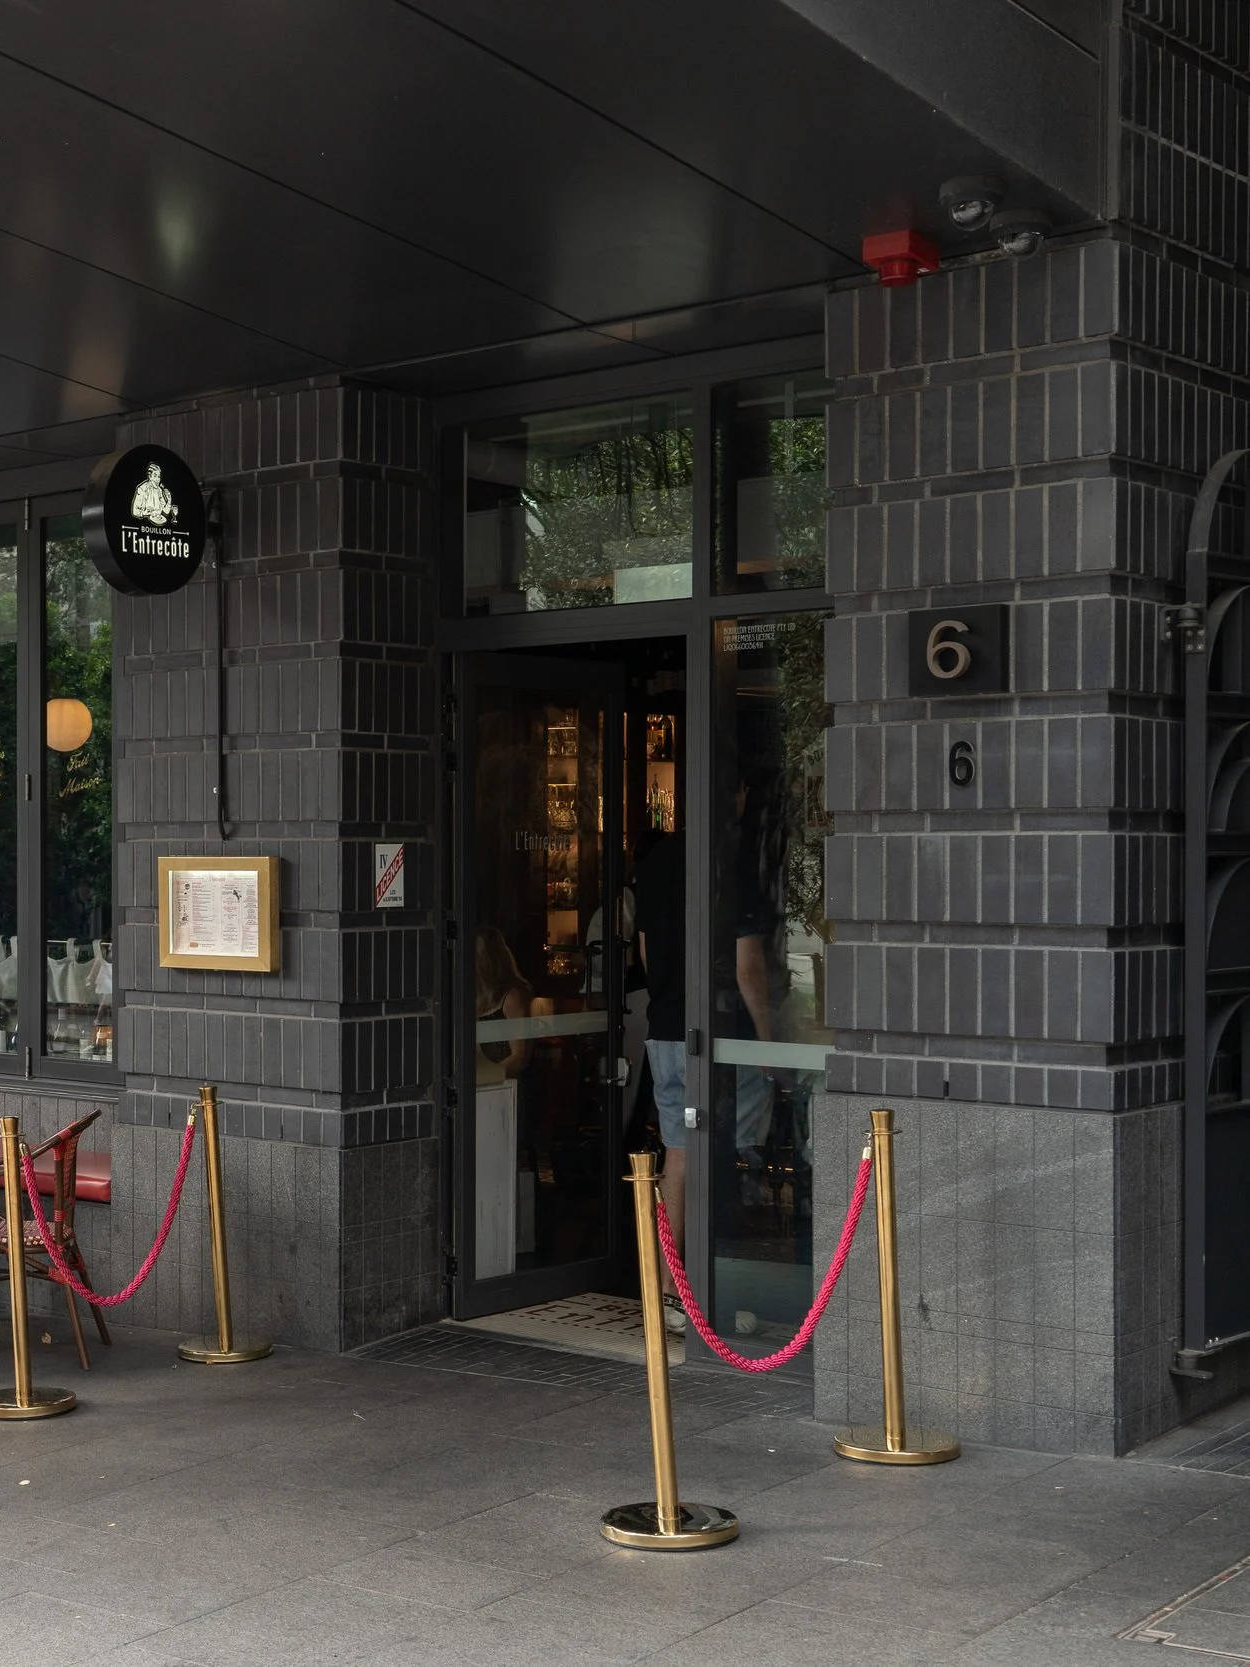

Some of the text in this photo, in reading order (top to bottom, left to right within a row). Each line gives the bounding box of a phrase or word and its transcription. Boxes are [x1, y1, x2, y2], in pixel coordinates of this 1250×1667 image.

[122, 530, 189, 558] L'Entrecôte
[141, 525, 172, 536] BOUILLON
[926, 619, 972, 679] 6
[949, 740, 976, 786] 6
[376, 846, 406, 902] LICENCE
[379, 854, 388, 869] IV
